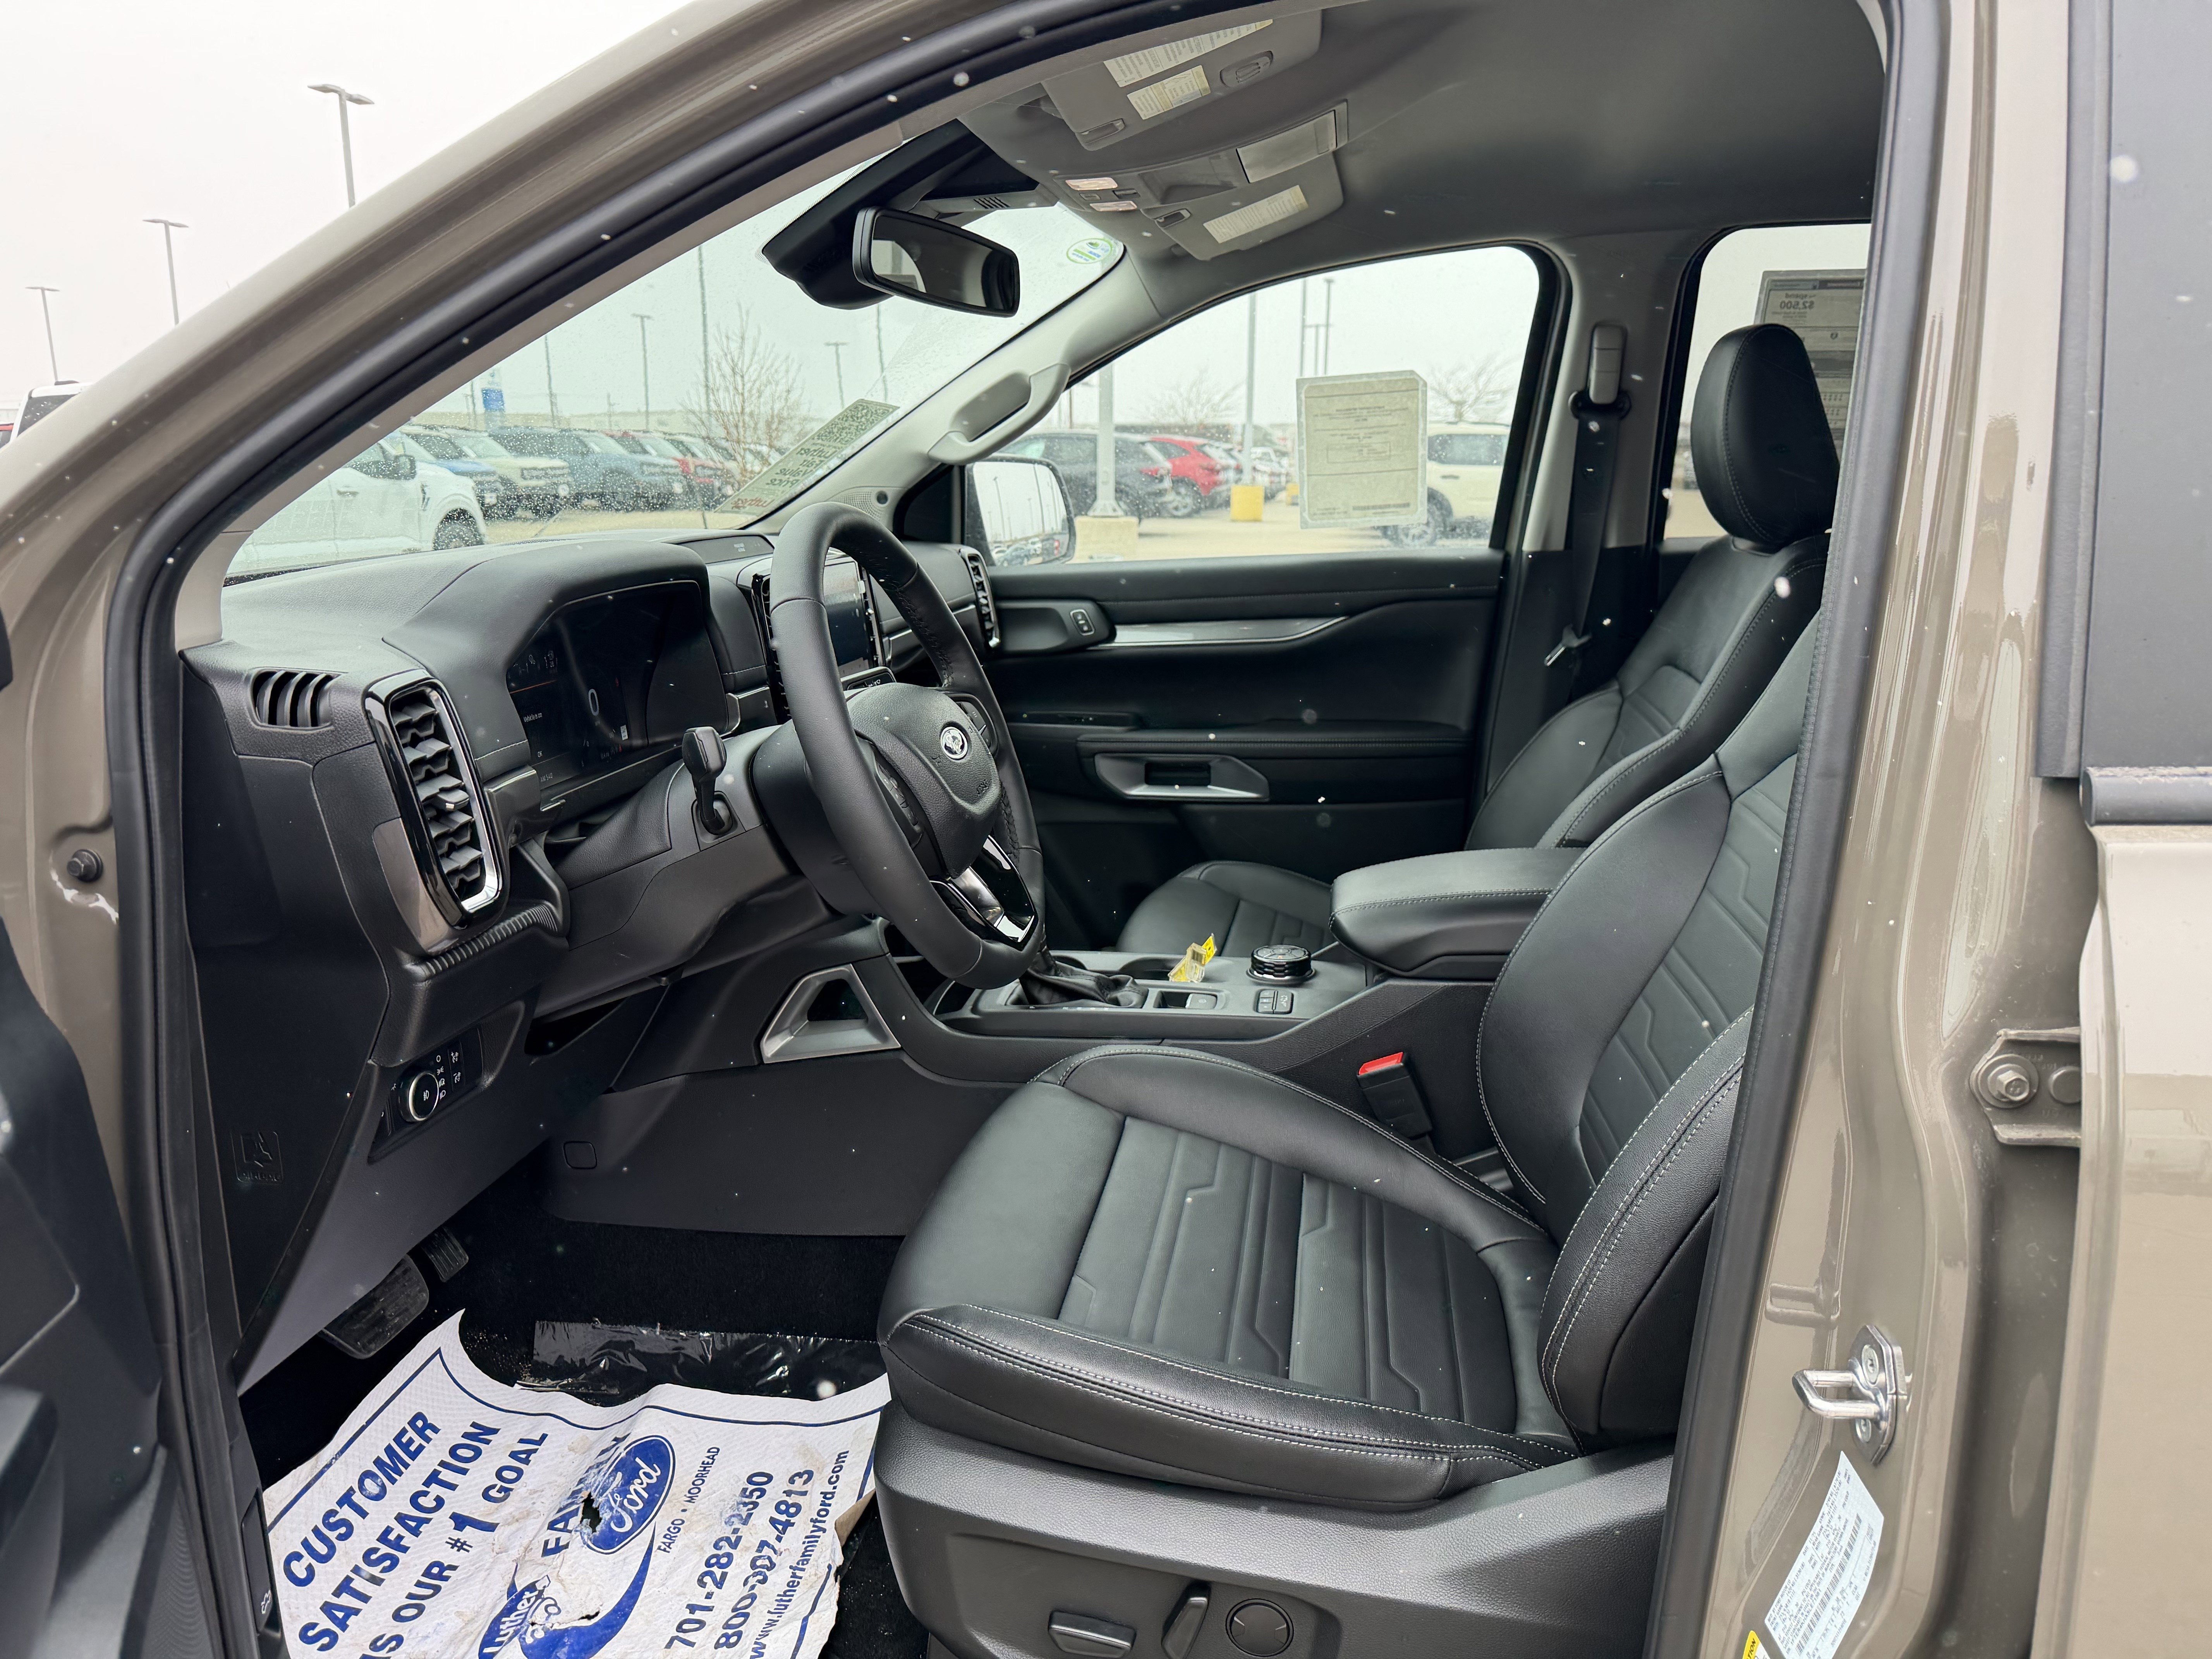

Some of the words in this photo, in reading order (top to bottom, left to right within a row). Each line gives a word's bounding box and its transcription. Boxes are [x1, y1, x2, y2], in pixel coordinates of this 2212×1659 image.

[588, 689, 599, 716] 0
[283, 1411, 441, 1587] CUSTOMER
[299, 1421, 502, 1652] SATISFACTION
[392, 1560, 460, 1623] OUR
[445, 1511, 500, 1553] #1
[481, 1432, 548, 1504] GOAL
[601, 1456, 662, 1533] Ford
[657, 1518, 685, 1553] FARGO
[687, 1446, 720, 1503] MOORHEAD
[664, 1471, 774, 1649] 701-282-2350
[714, 1469, 814, 1650] 800-307-4813
[750, 1450, 849, 1659] www.lutherfamilyford.com
[483, 1590, 539, 1653] Luther
